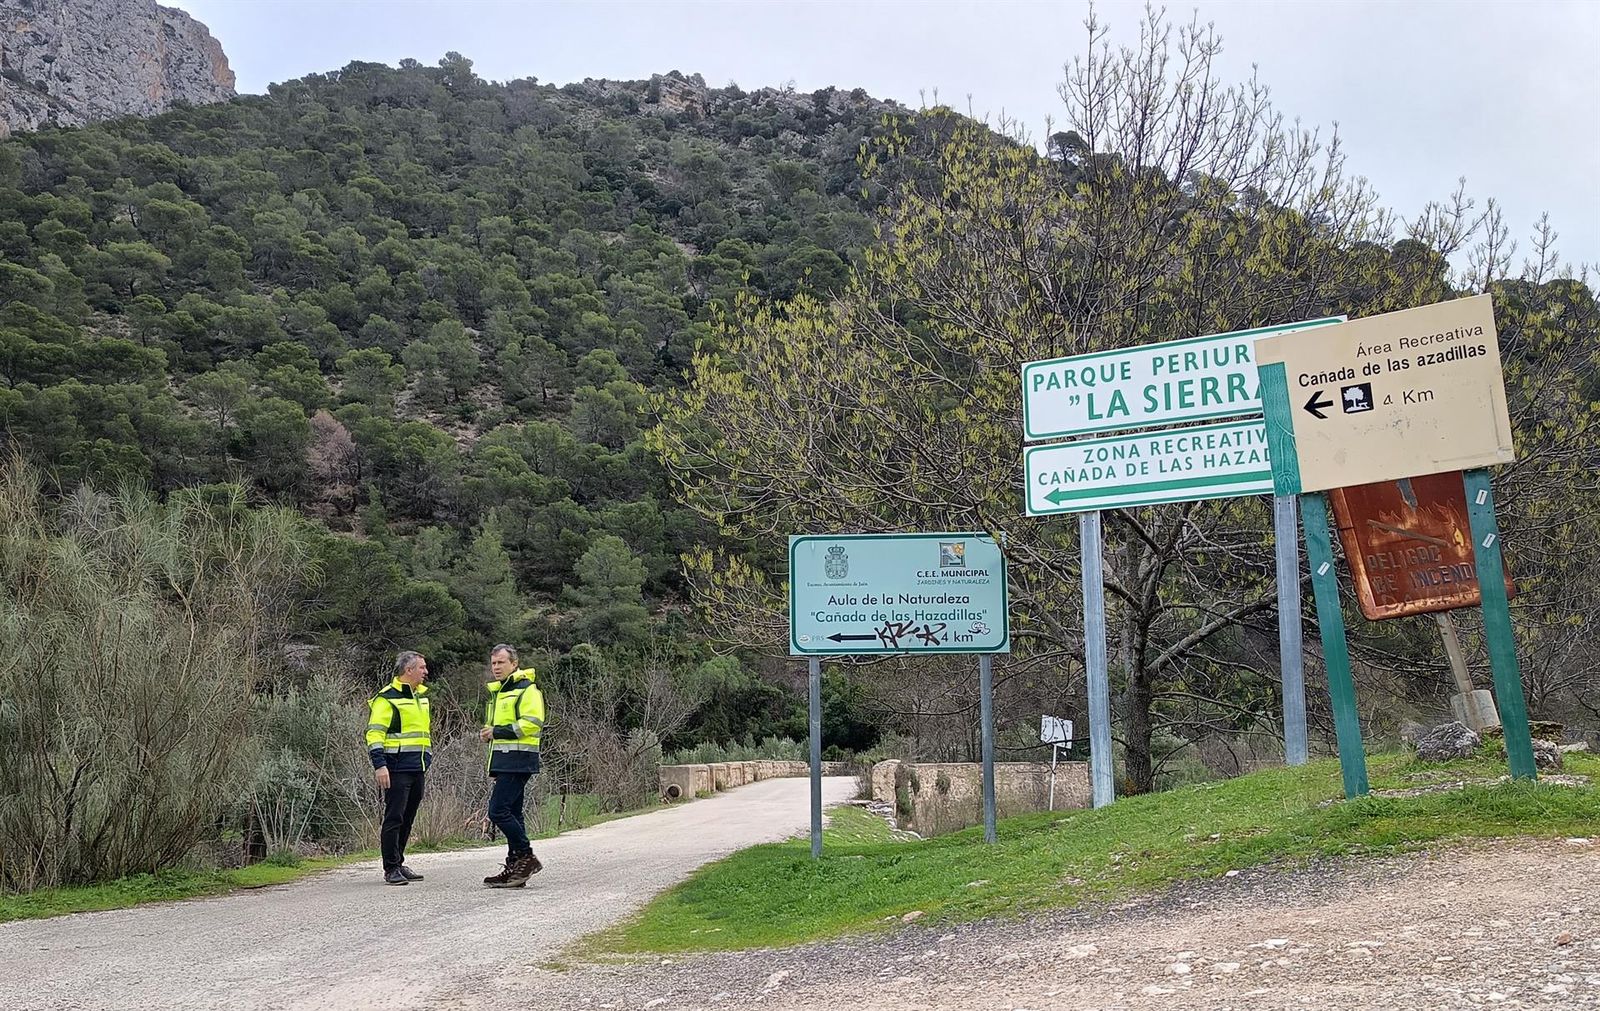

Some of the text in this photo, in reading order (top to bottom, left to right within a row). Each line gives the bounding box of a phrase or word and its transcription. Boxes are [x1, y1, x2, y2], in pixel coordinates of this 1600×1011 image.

[1356, 325, 1483, 358] Área Recreativa
[1032, 344, 1251, 392] PARQUE PERIUR
[1298, 344, 1487, 388] Cañada de las azadillas
[1143, 372, 1261, 413] SIERR
[1383, 389, 1434, 406] 4 Km
[1083, 428, 1267, 464] ZONA RECREATIV
[1038, 466, 1117, 486] CAÑADA
[1126, 461, 1149, 477] DE
[1159, 457, 1193, 473] LAS
[916, 569, 990, 578] C.E.E. MUNICIPAL
[1408, 561, 1476, 588] INCEND
[827, 592, 970, 606] Aula de la Naturaleza
[811, 608, 987, 623] "Cañada de las Hazadillas"
[940, 630, 949, 642] 4
[953, 630, 974, 642] km
